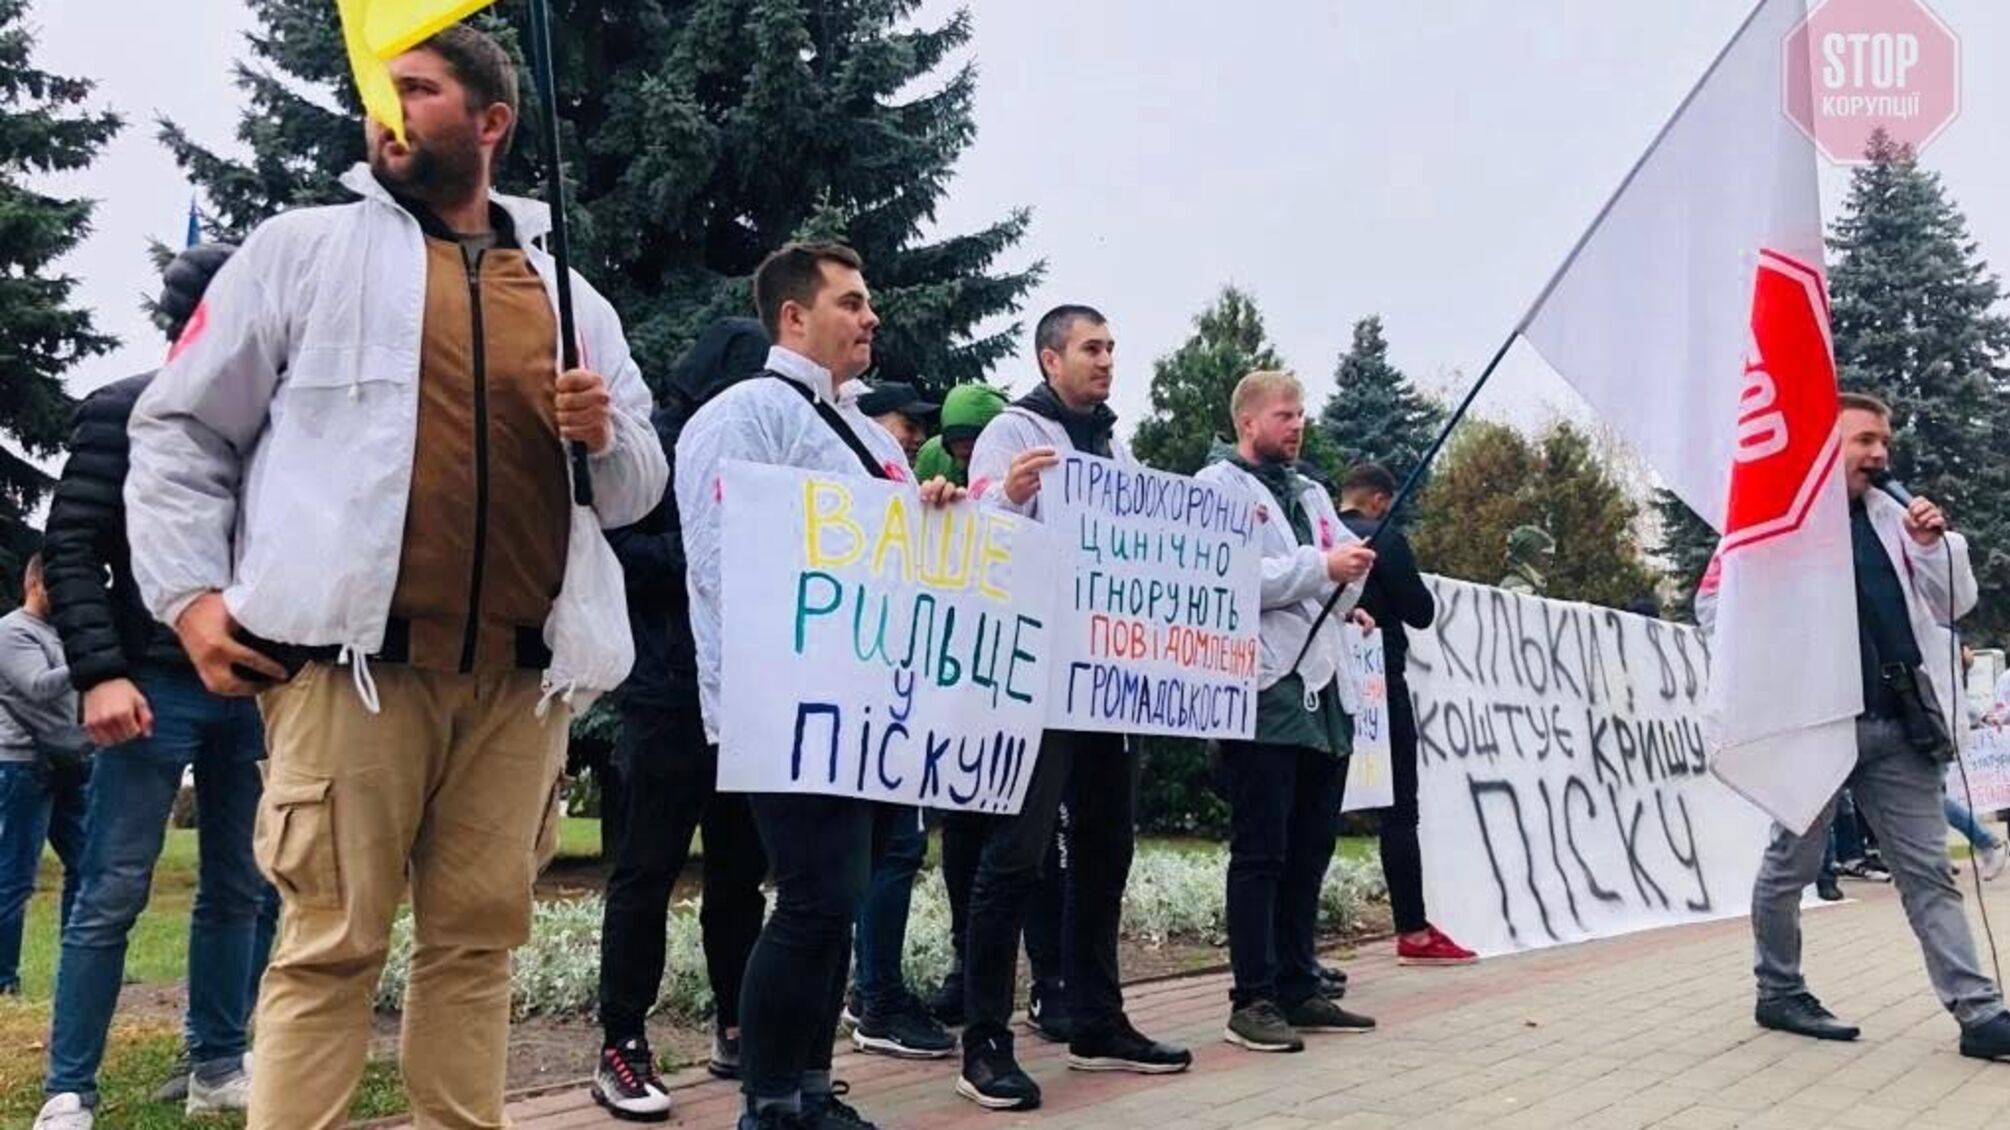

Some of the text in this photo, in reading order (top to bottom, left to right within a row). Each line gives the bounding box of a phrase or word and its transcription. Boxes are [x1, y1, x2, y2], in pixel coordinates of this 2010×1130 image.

[804, 479, 1017, 600] ВАШЕ
[1065, 458, 1258, 548] ПРАВООХОРОНЦІ
[1081, 514, 1230, 577] ЦИНІЧНО
[794, 571, 1043, 709] РИЛЬЦЕ
[1076, 566, 1239, 631] ІГНОРУЮТЬ
[1066, 662, 1248, 733] ГРОМАДСЬКОСТІ
[791, 702, 1027, 813] ПІСКУ!!!
[1466, 772, 1712, 941] ПІСКУ
